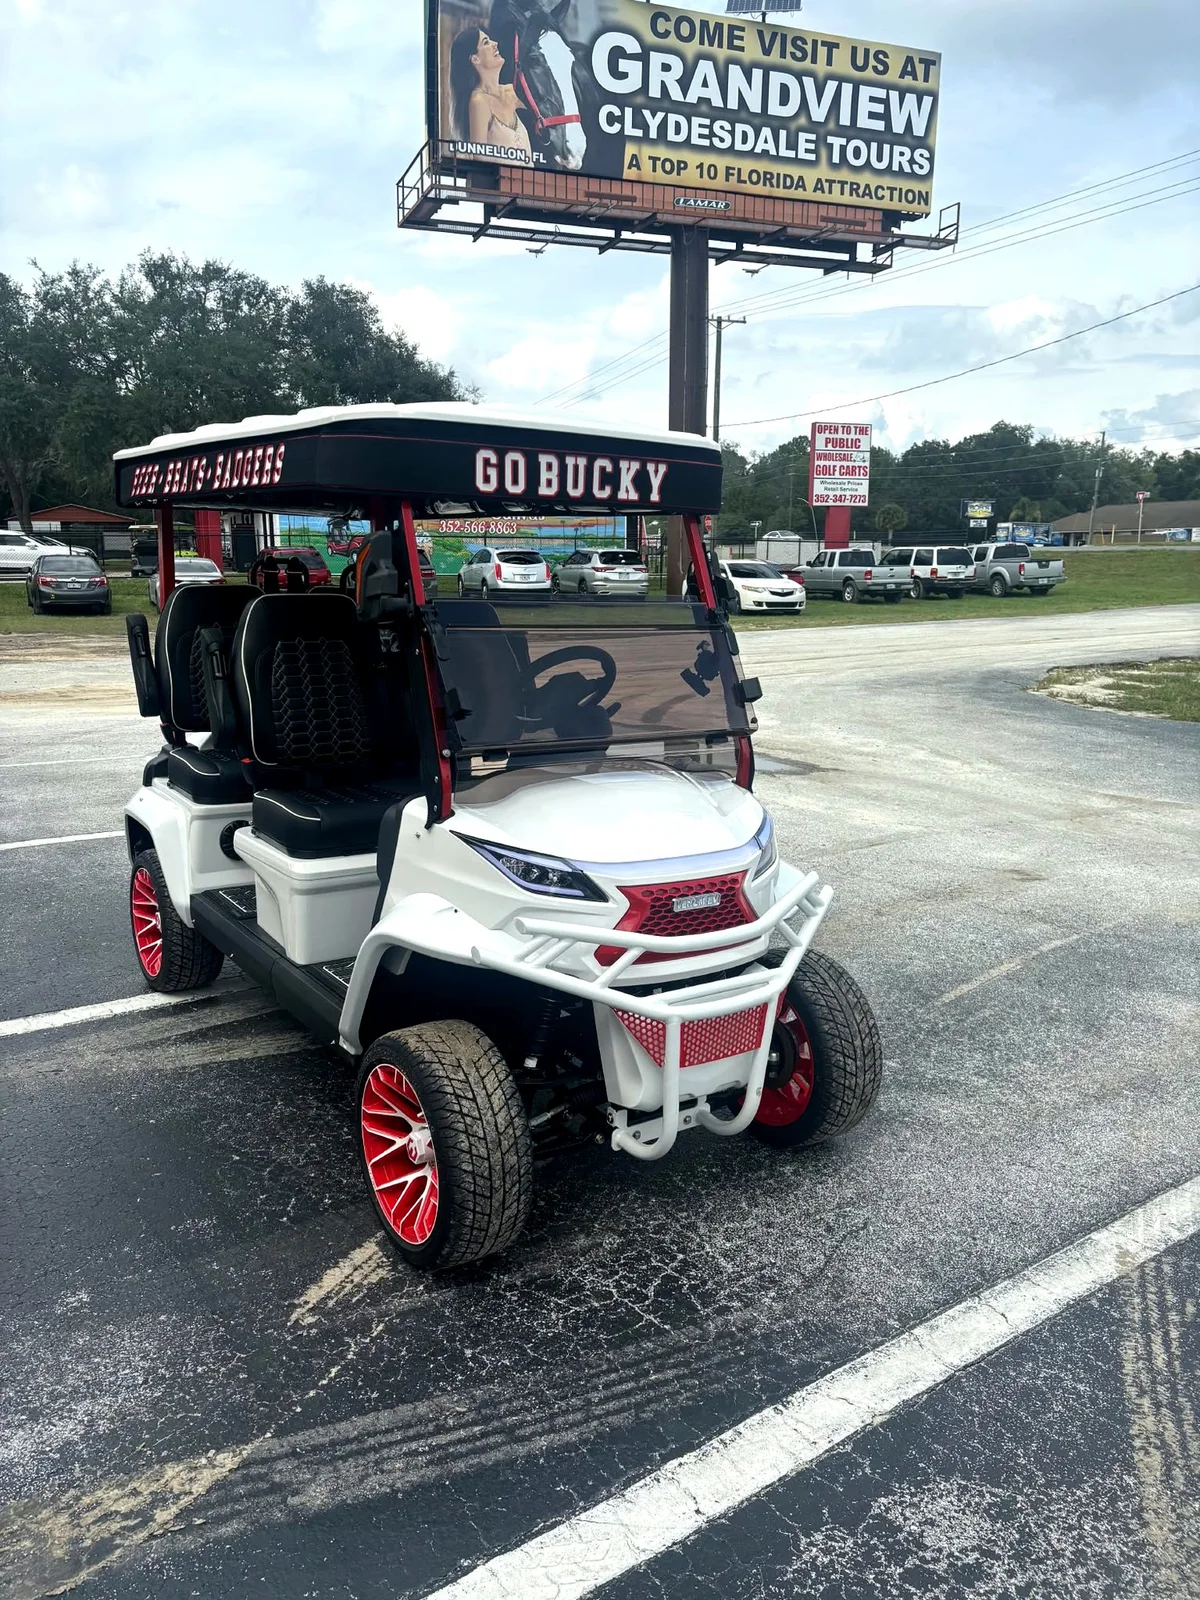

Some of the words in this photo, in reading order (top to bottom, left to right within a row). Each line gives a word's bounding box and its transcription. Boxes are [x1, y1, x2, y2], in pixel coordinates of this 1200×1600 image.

[650, 11, 745, 52] COME
[756, 29, 840, 67] VISIT
[850, 46, 890, 76] US
[898, 55, 936, 83] AT
[591, 32, 934, 137] GRANDVIEW
[599, 104, 817, 161] CLYDESDALE
[826, 135, 931, 175] TOURS
[533, 152, 547, 163] FL
[627, 153, 642, 171] A
[648, 155, 688, 177] TOP
[695, 162, 718, 181] 10
[725, 165, 807, 192] FLORIDA
[812, 177, 930, 206] ATTRACTION
[679, 198, 726, 209] LAMAR
[817, 424, 839, 435] OPEN
[841, 425, 852, 435] TO
[854, 426, 869, 436] THE
[825, 437, 861, 449] PUBLIC
[816, 452, 853, 462] WHOLESALE
[475, 449, 527, 495] GO
[538, 453, 668, 502] BUCKY
[815, 465, 837, 476] GOLF
[839, 465, 868, 477] CARTS
[814, 494, 867, 504] 352-347-7273
[440, 520, 517, 534] 352-566-8863
